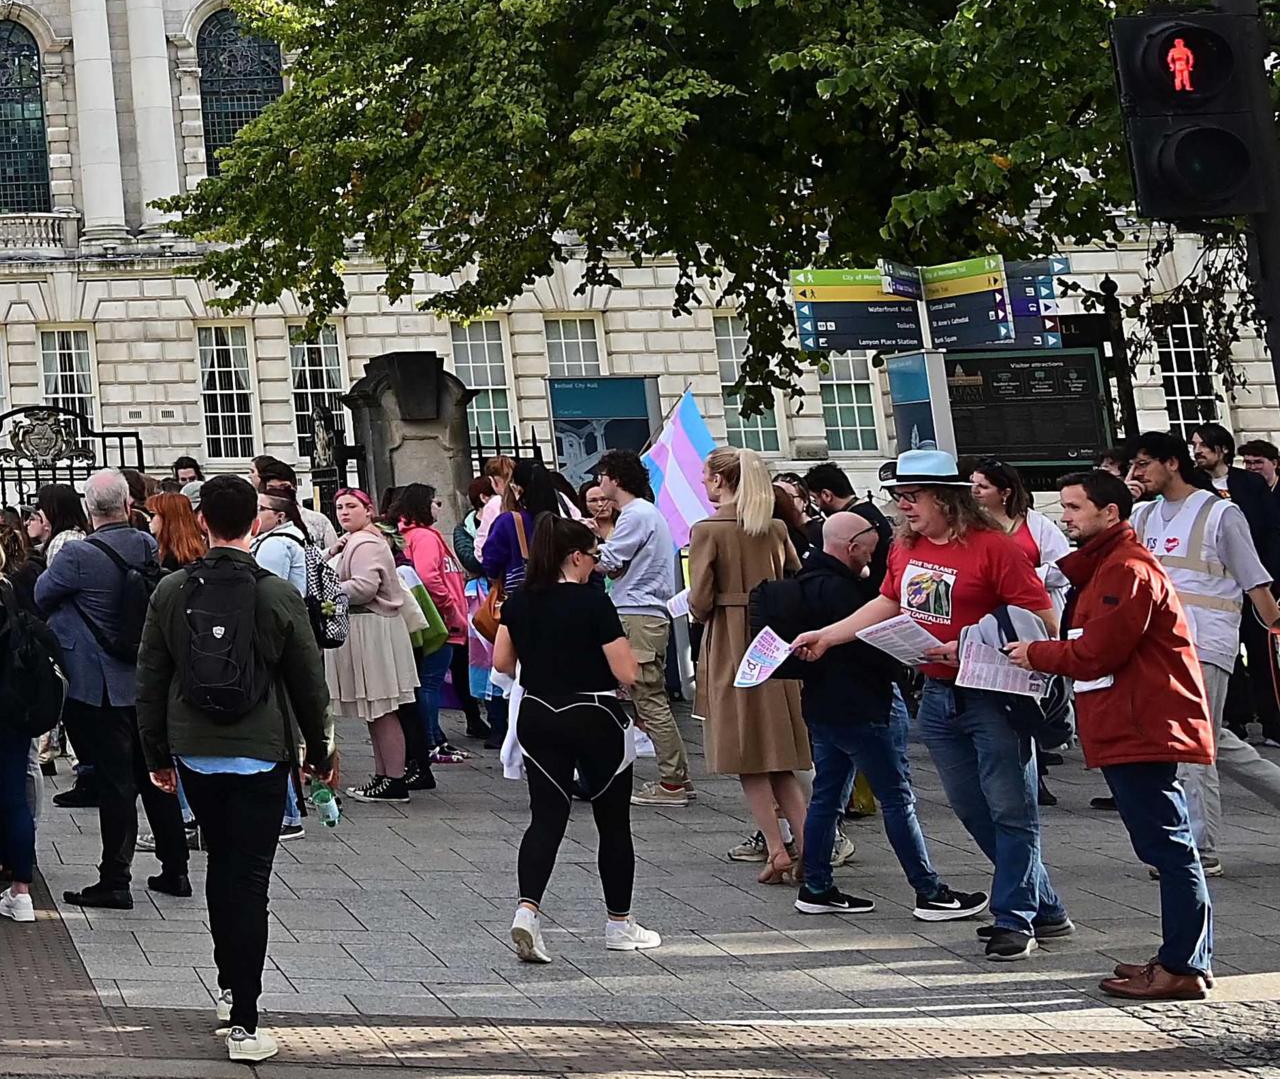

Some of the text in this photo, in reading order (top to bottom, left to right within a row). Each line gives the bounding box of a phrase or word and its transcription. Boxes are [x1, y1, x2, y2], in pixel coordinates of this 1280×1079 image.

[859, 338, 879, 346] Lanyon
[909, 558, 922, 566] SAVE
[933, 563, 958, 575] PLANET
[912, 611, 951, 625] CAPITALISM
